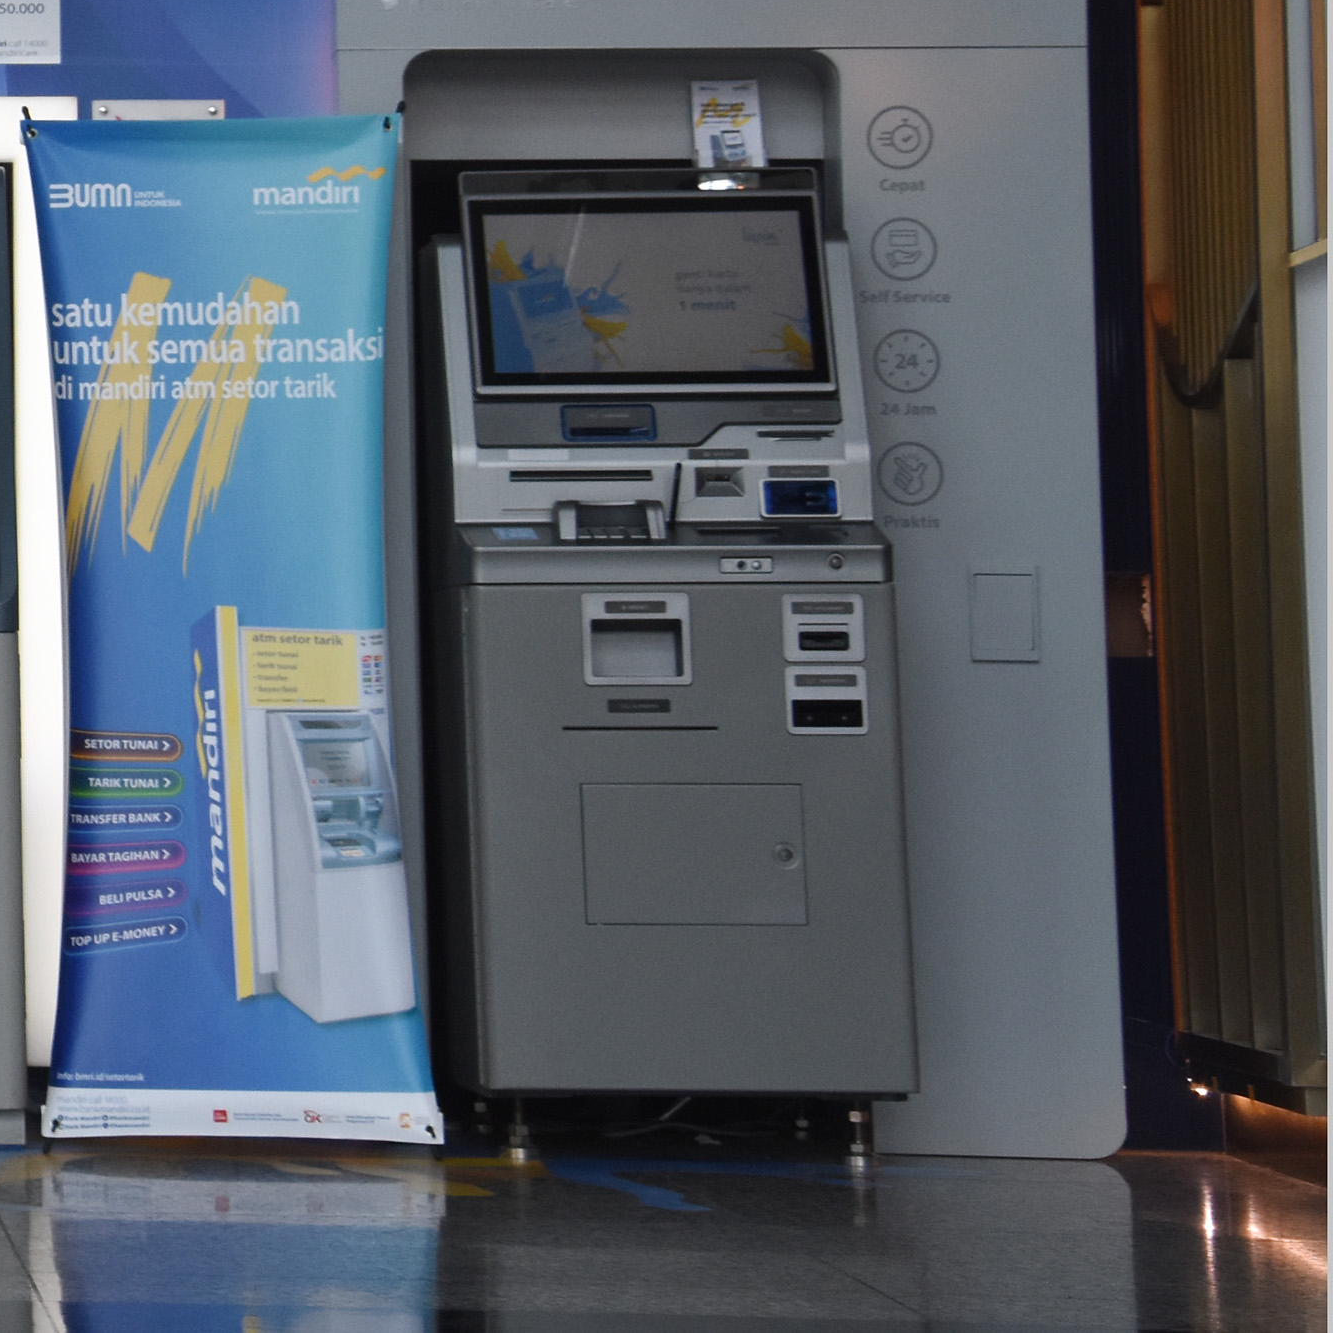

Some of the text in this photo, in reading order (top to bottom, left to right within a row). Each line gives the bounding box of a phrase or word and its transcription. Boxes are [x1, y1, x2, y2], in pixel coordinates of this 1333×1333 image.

[253, 180, 360, 206] mandiri
[879, 178, 926, 194] Cepat
[49, 182, 132, 209] BUMN
[134, 190, 165, 199] UNTUK
[134, 199, 182, 208] INDONESIA
[859, 290, 951, 304] Self Service
[51, 292, 300, 327] satu kemudahan
[52, 327, 383, 365] untuk semua transaksi
[894, 353, 919, 369] 24
[53, 373, 337, 400] di mandiri atm setor tarik
[880, 403, 936, 416] 24 Jam
[884, 515, 940, 530] Praktis
[252, 633, 343, 646] atm setor tarik
[84, 739, 158, 751] SETOR TUNAI
[88, 777, 160, 789] TARIK TUNAI
[203, 689, 226, 897] mandiri
[70, 813, 161, 824] TRANSFER BANK
[70, 850, 160, 863] BAYAR TAGIHAN
[99, 889, 163, 905] BELI PULSA
[70, 925, 166, 947] TOP UP E-MONEY
